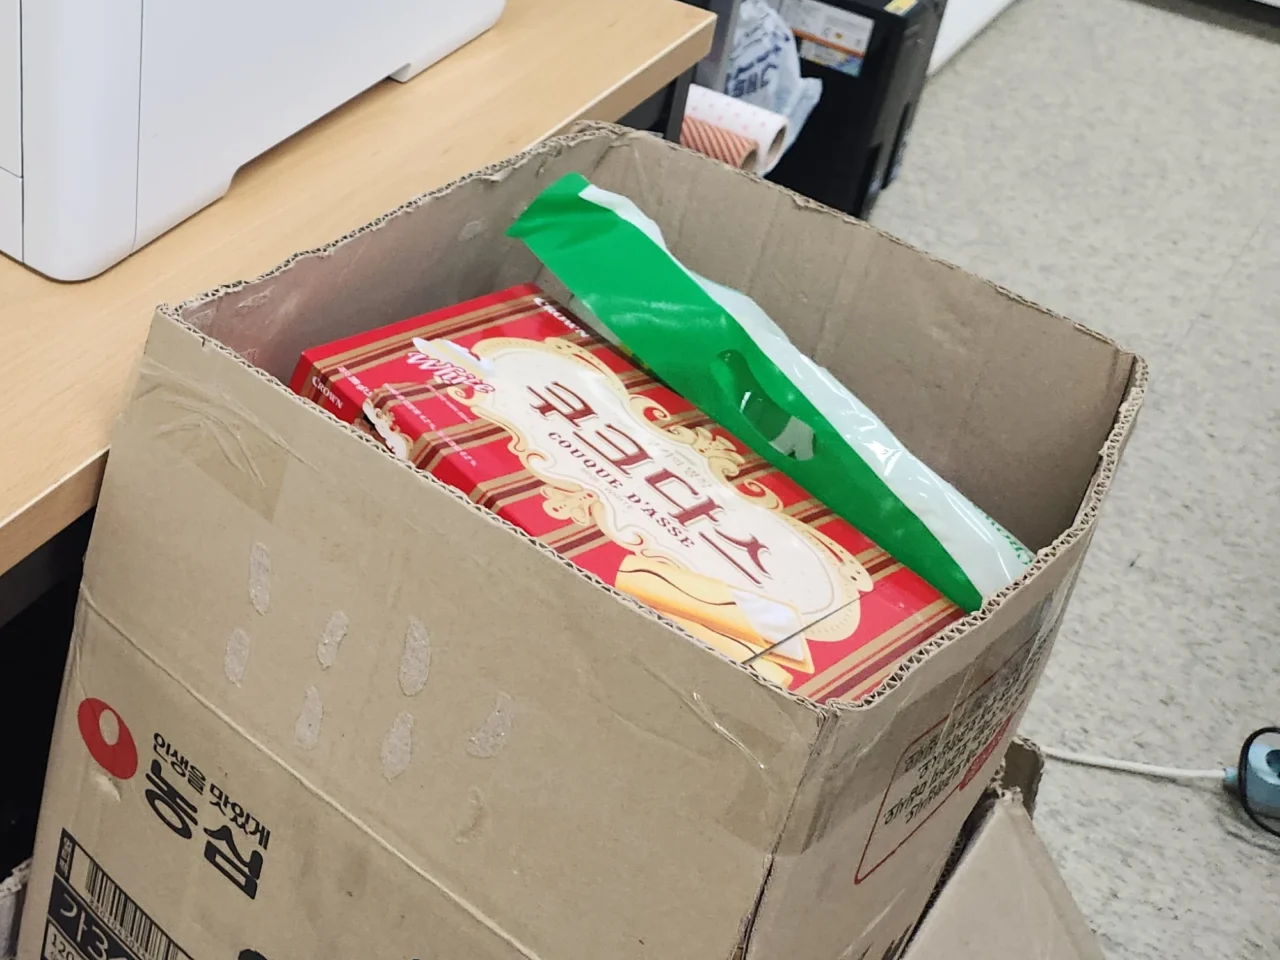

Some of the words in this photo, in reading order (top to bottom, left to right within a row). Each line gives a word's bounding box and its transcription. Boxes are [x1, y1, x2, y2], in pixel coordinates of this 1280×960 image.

[406, 351, 496, 394] White
[533, 296, 591, 338] CROWN
[311, 375, 344, 410] CROWN
[525, 380, 772, 587] 쿠크다스
[547, 431, 624, 490] COUQUE
[626, 491, 696, 549] D'ASSE
[144, 758, 264, 900] 농심
[153, 732, 207, 797] 인생을
[209, 782, 271, 851] 맛있게
